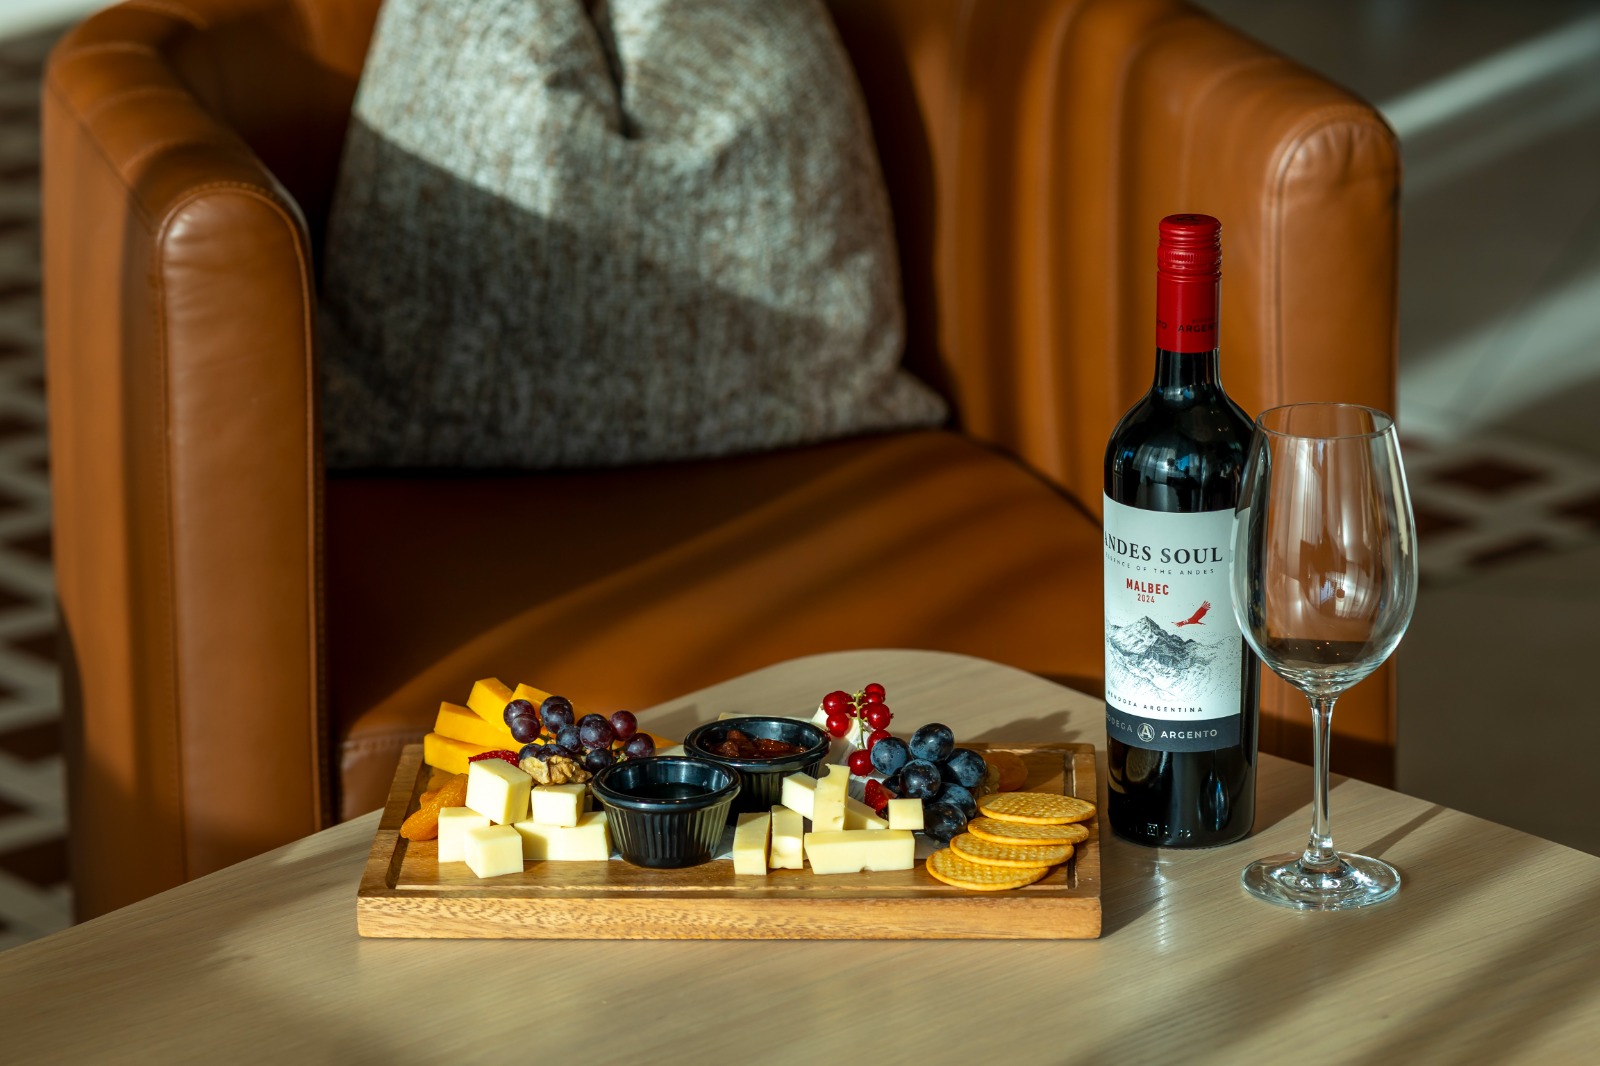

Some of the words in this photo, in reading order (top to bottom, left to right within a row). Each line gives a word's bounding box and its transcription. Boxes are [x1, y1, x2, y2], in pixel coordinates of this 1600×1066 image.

[1160, 547, 1223, 565] SOUL
[1126, 578, 1170, 596] MALBEC
[1137, 593, 1155, 603] 2024
[1143, 704, 1203, 713] ARGENTINA
[1160, 729, 1218, 739] ARGENTO
